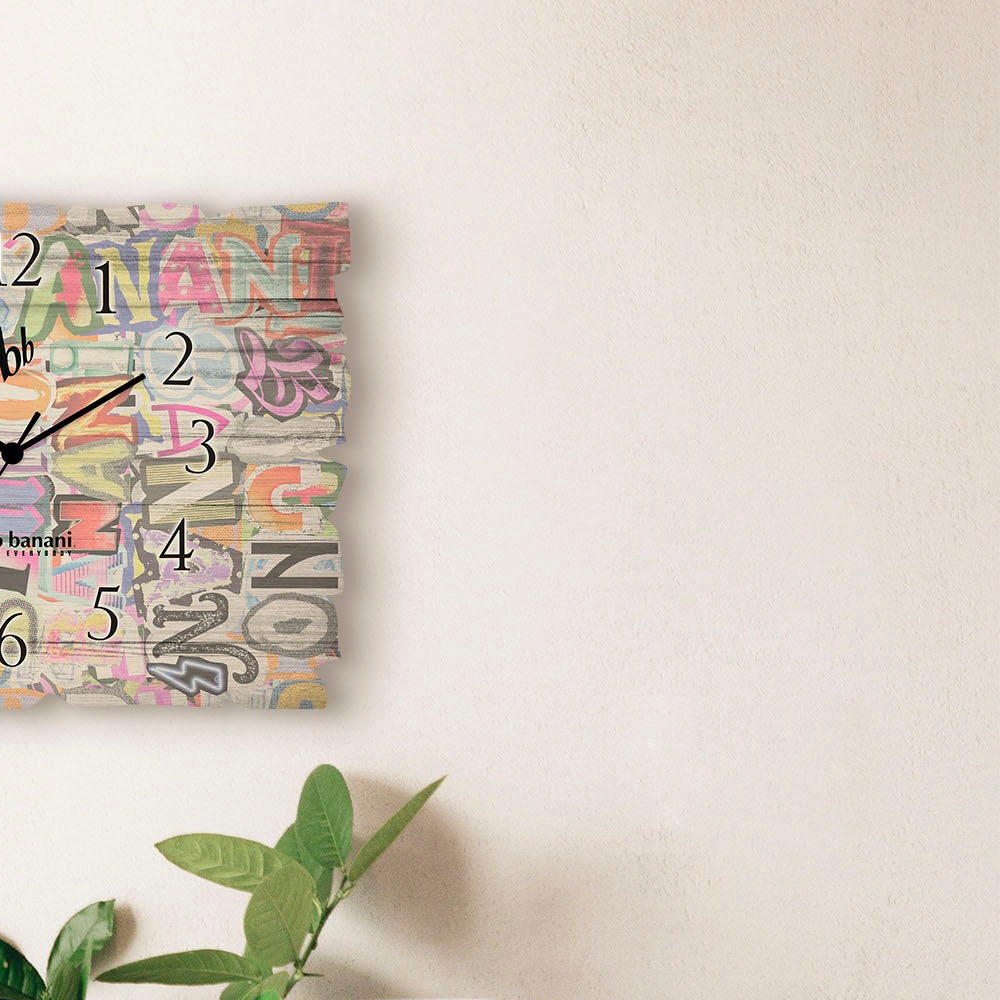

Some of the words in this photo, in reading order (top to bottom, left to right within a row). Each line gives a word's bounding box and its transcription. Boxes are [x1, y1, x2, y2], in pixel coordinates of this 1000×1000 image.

[95, 260, 117, 315] 1
[162, 332, 194, 386] 2
[185, 420, 217, 474] 3
[8, 531, 72, 548] banani
[159, 517, 195, 571] 4
[87, 585, 121, 640] 5
